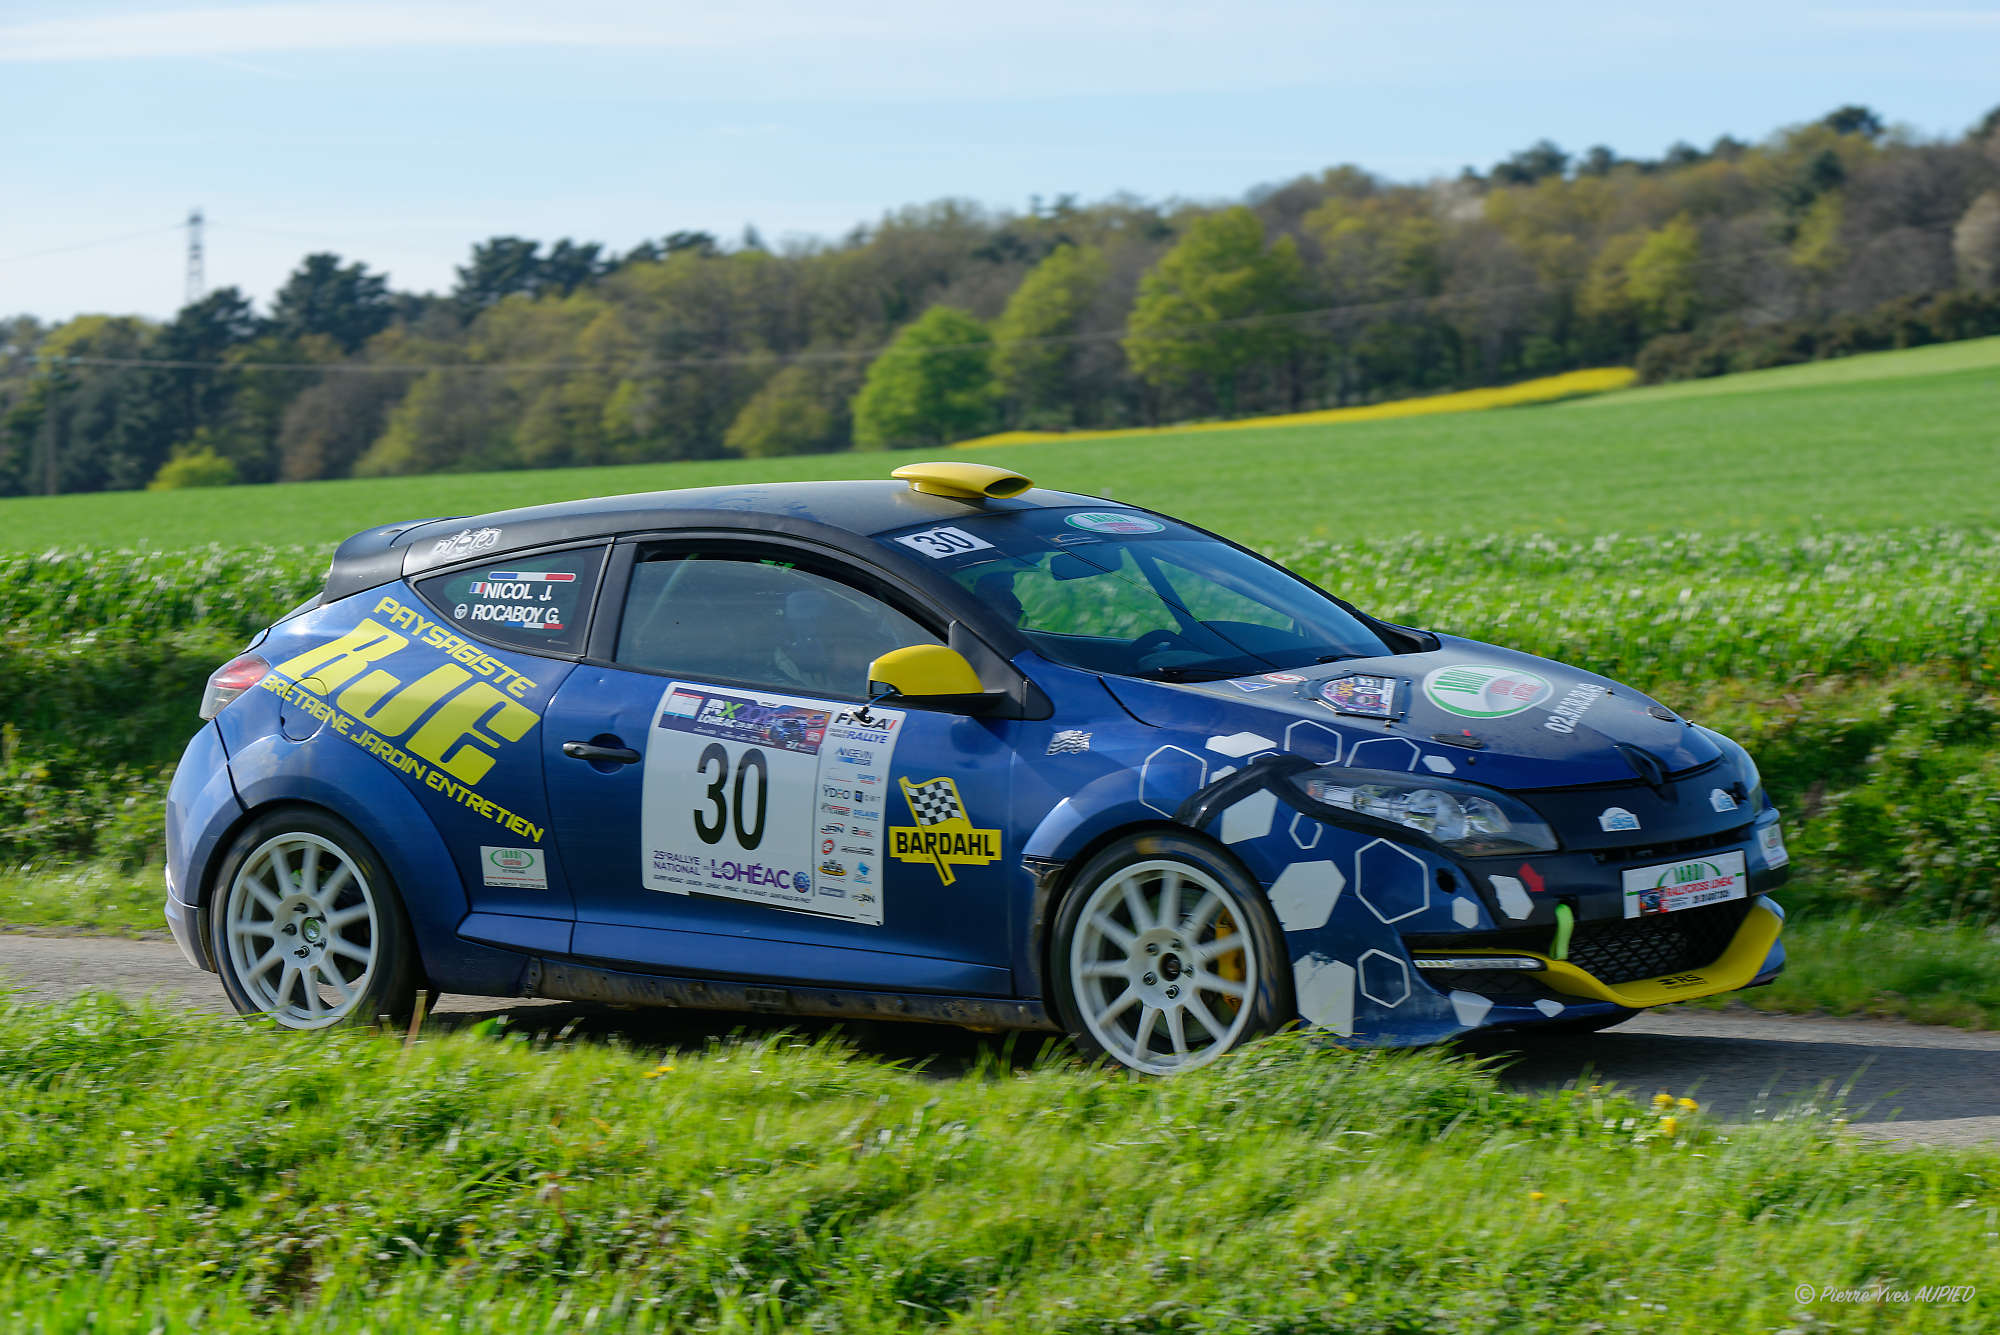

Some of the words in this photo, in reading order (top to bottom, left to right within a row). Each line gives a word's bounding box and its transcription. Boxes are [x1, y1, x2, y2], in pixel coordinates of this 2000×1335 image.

[914, 531, 976, 554] 30
[482, 582, 533, 600] NICOL
[539, 585, 553, 601] J.
[471, 604, 544, 624] ROCABOY
[545, 607, 560, 624] G.
[373, 596, 538, 699] PAYSAGISTE
[260, 674, 356, 736] BRETAGNE
[847, 730, 888, 744] RALLYE
[350, 730, 428, 780] JARDIN
[425, 770, 545, 843] ENTRETIEN
[694, 743, 768, 851] 30
[896, 832, 995, 857] BARDAHL
[653, 861, 701, 876] NATIONAL
[711, 859, 791, 889] LOHÉAC
